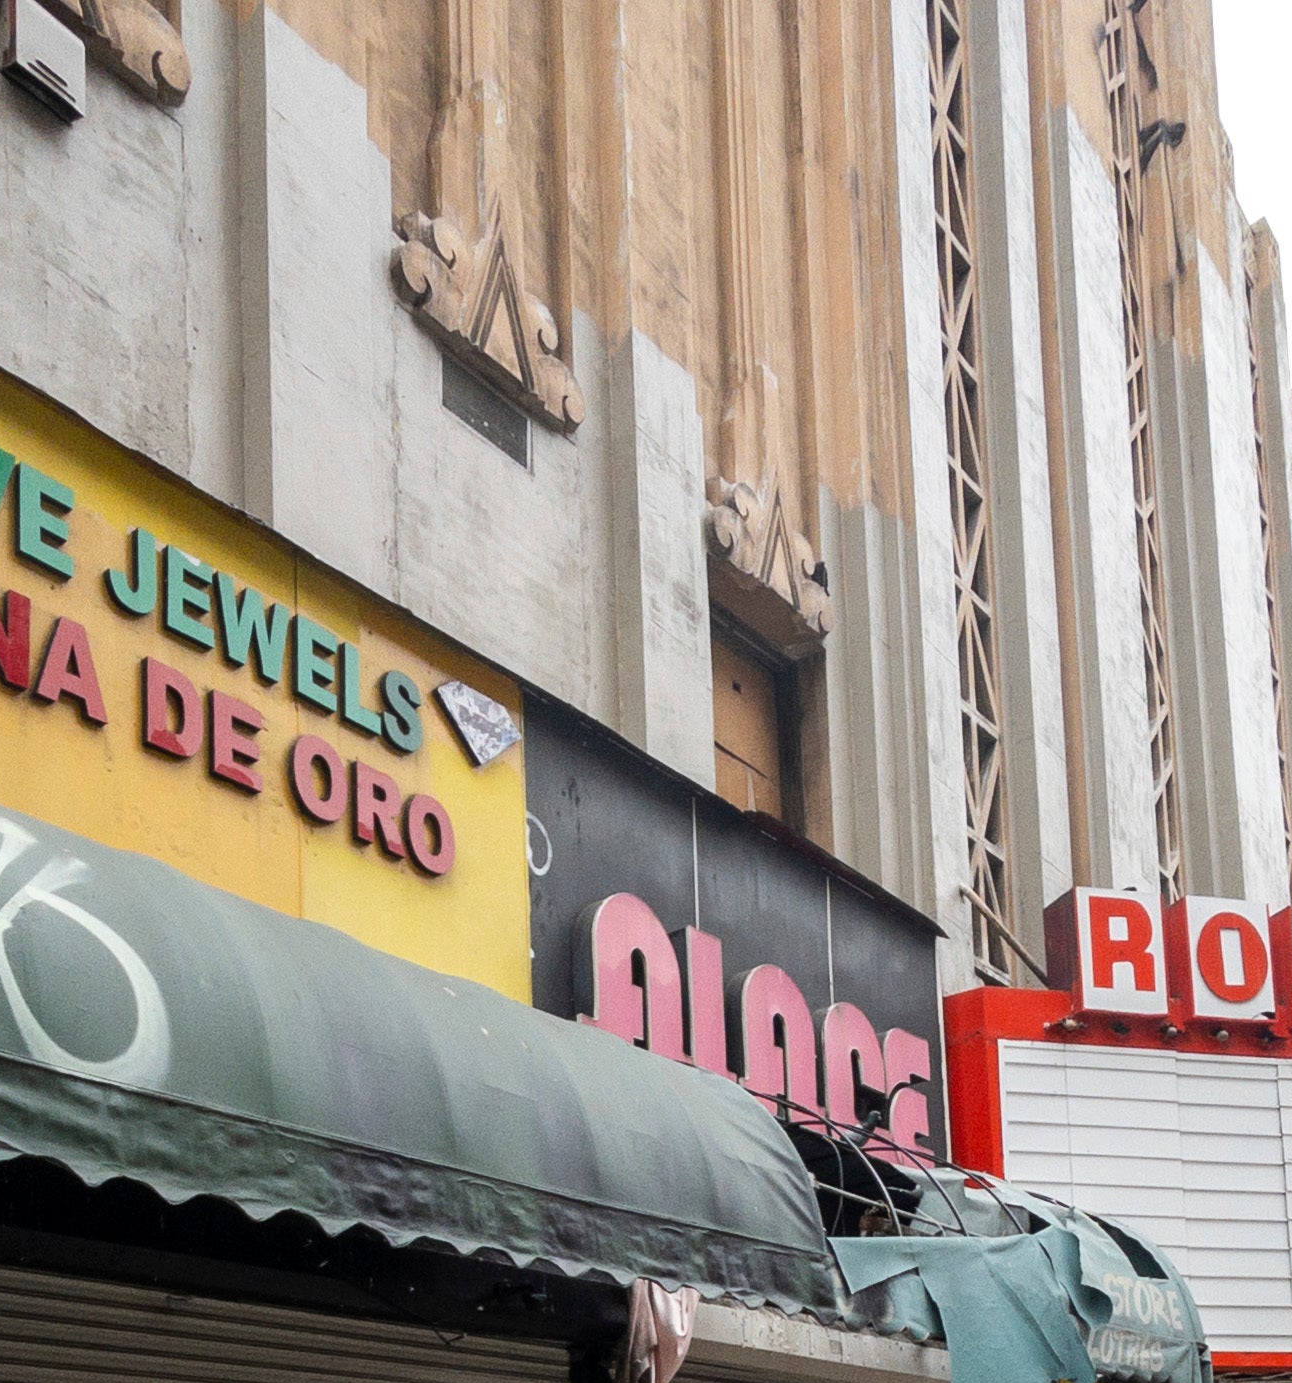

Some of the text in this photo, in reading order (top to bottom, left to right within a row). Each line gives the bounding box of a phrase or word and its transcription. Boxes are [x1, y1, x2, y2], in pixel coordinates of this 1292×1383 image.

[107, 524, 424, 754] JEWELS
[142, 655, 265, 794] DE
[290, 734, 456, 876] ORO
[1087, 1328, 1164, 1373] LOTHES
[1103, 1272, 1184, 1331] STORE
